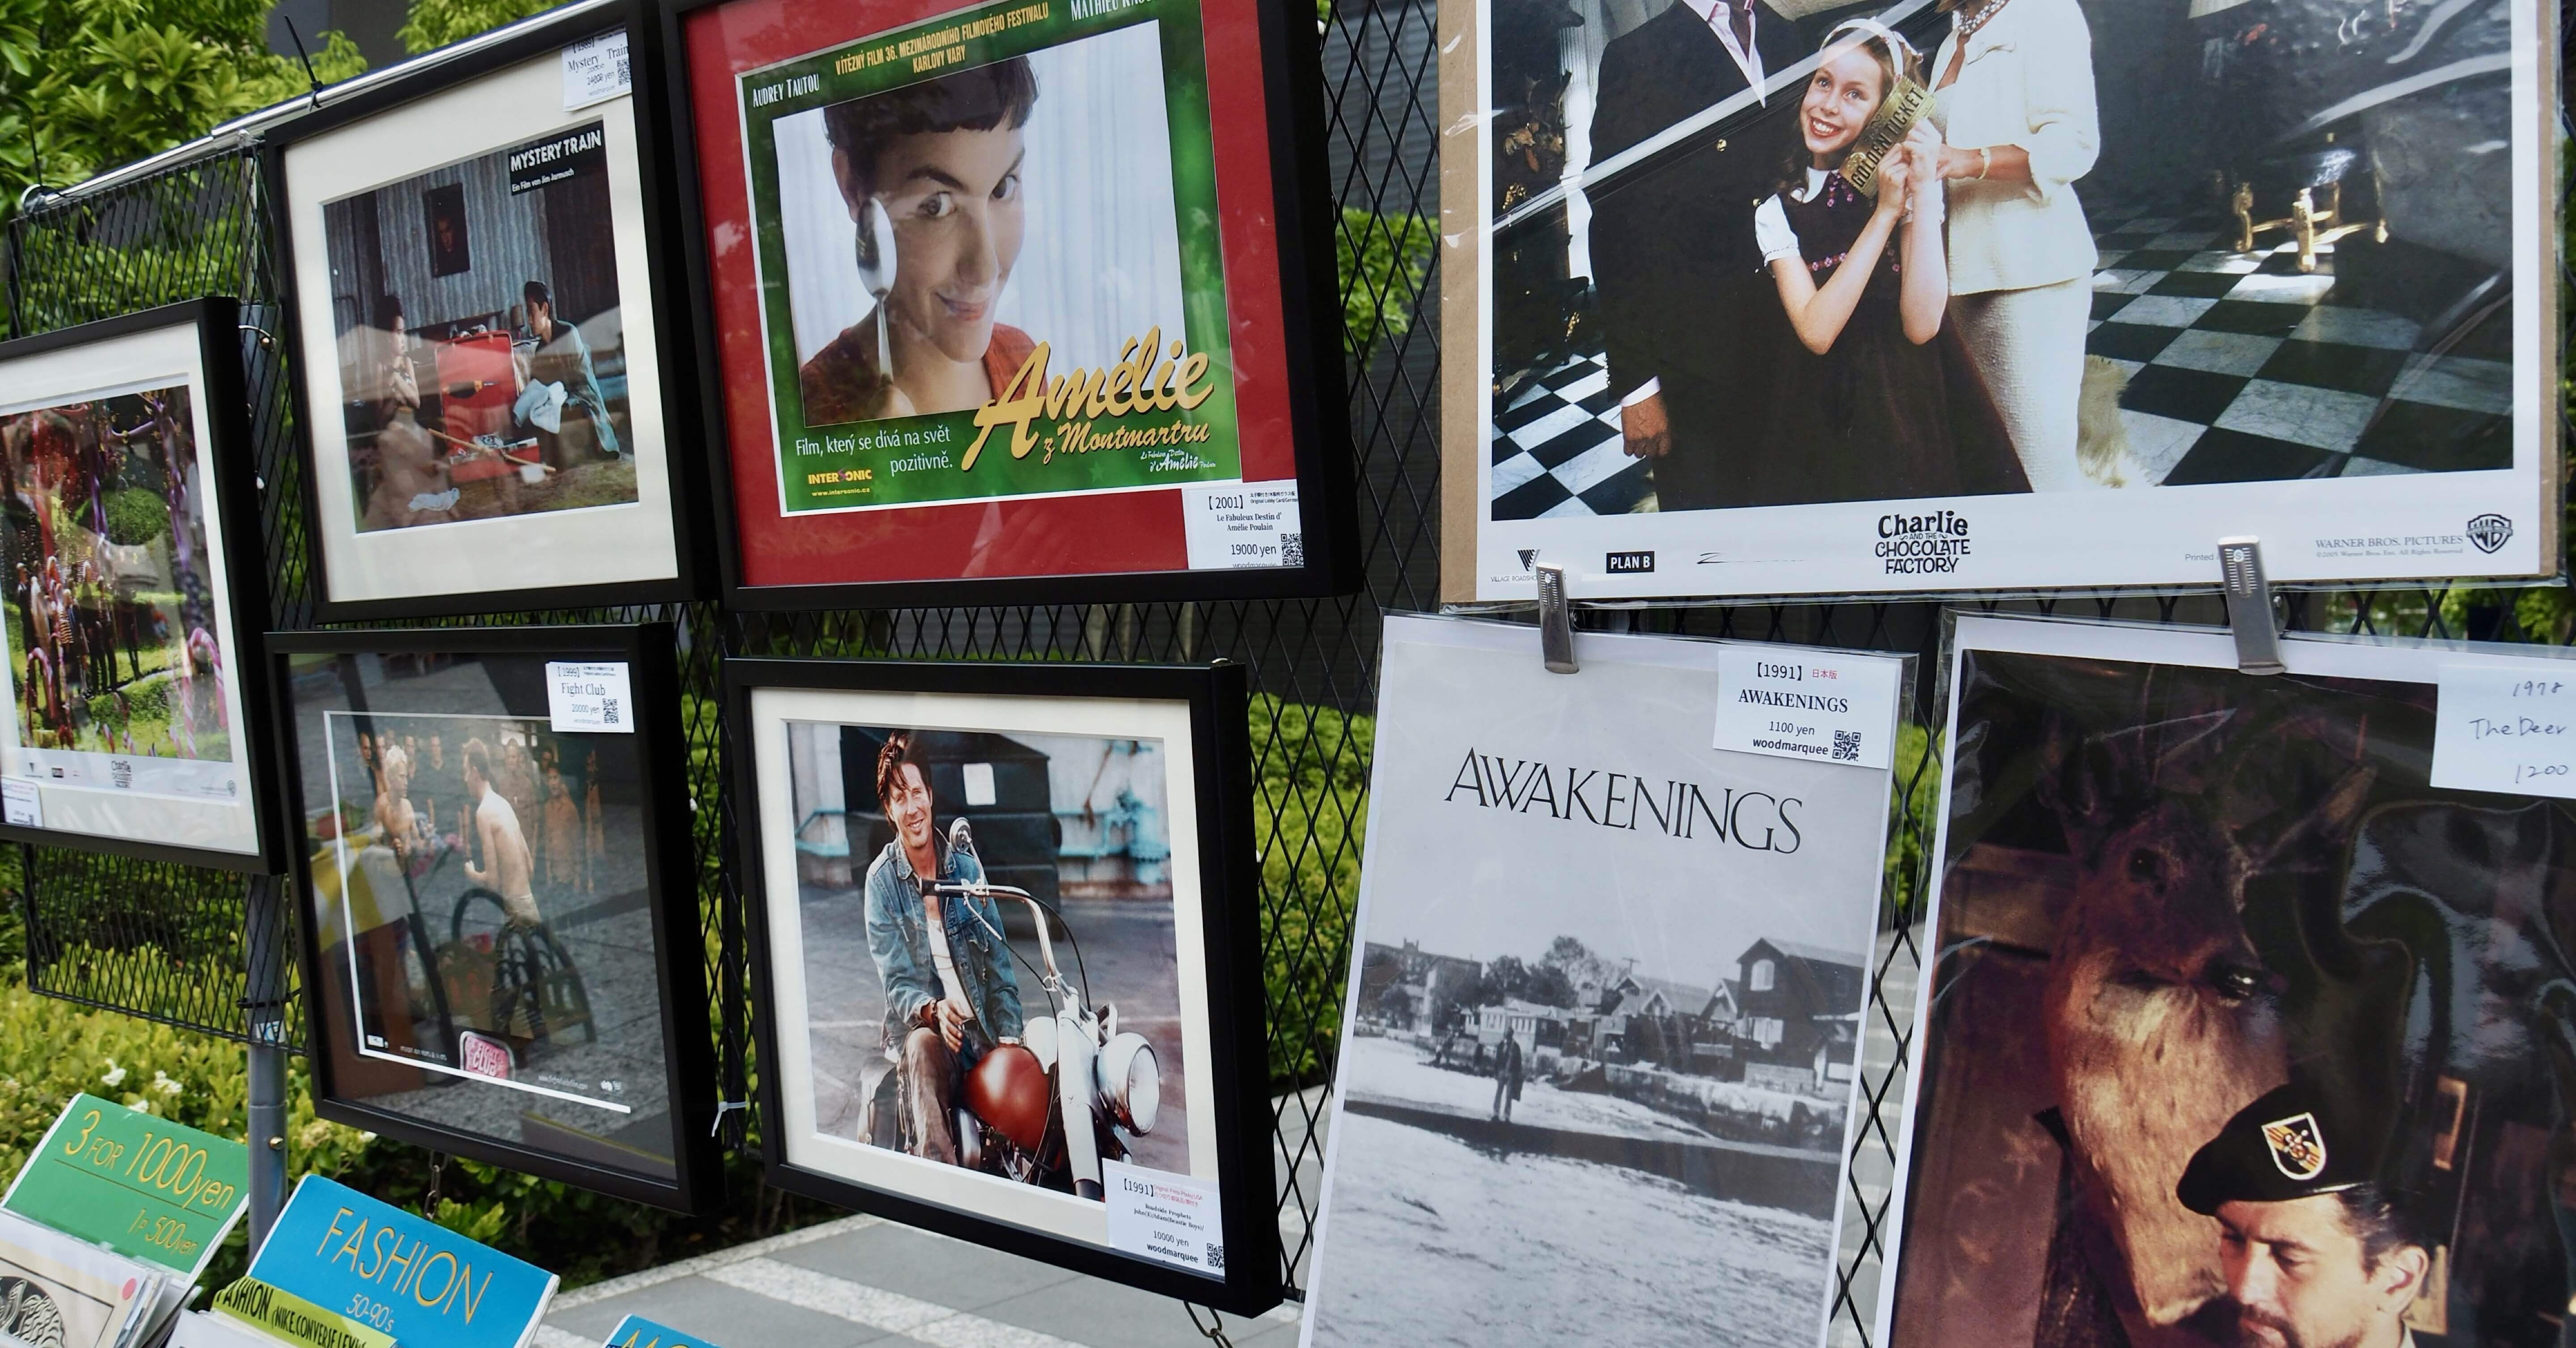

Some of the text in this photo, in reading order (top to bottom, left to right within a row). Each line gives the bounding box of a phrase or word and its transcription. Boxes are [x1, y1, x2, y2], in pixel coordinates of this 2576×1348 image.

[835, 2, 1049, 75] VÍTĚZNÝ FILM 36. MEZINÁRODNÍHO FILMOVÉHO FESTIVALU
[568, 55, 599, 73] Mystery
[913, 45, 965, 73] KARLOVY VARY
[753, 73, 819, 107] AUDREY TAUTOU
[1851, 87, 1924, 188] GOLDEN TICKET
[511, 130, 602, 172] MYSTERY TRAIN
[520, 181, 531, 190] Film
[961, 325, 1214, 471] Amélie
[796, 424, 951, 457] Film, který se dívá na svět
[1043, 419, 1210, 465] z Montmartru
[890, 450, 953, 477] pozitivně.
[808, 467, 872, 484] INTERSONIC
[812, 488, 870, 496] www.intersonic.cz
[1878, 510, 1968, 538] Charlie
[1231, 544, 1277, 558] 19000 yen
[1875, 539, 1971, 558] CHOCOLATE
[2316, 536, 2463, 548] WARNER BROS. PICTURES
[1610, 554, 1651, 569] PLAN B
[1885, 556, 1960, 574] FACTORY
[1812, 669, 1838, 680] 日本版
[561, 683, 606, 697] Fight Club
[2513, 680, 2564, 697] 1978
[1738, 689, 1848, 713] AWAKENINGS
[1768, 721, 1815, 737] 1100 yen
[2469, 716, 2567, 739] The Deer
[1753, 738, 1829, 755] woodmarquee
[2515, 764, 2569, 784] 1200
[1444, 747, 1803, 854] AWAKENINGS
[473, 1052, 497, 1077] CLUB
[65, 1110, 101, 1156] 3
[84, 1137, 125, 1169] FOR
[1169, 1209, 1191, 1220] Prophets
[1153, 1230, 1189, 1247] 10000 yen
[1147, 1243, 1199, 1263] woodmarquee
[317, 1207, 494, 1326] FASHION
[216, 1279, 274, 1322] FASHION
[346, 1292, 394, 1332] 50-90's
